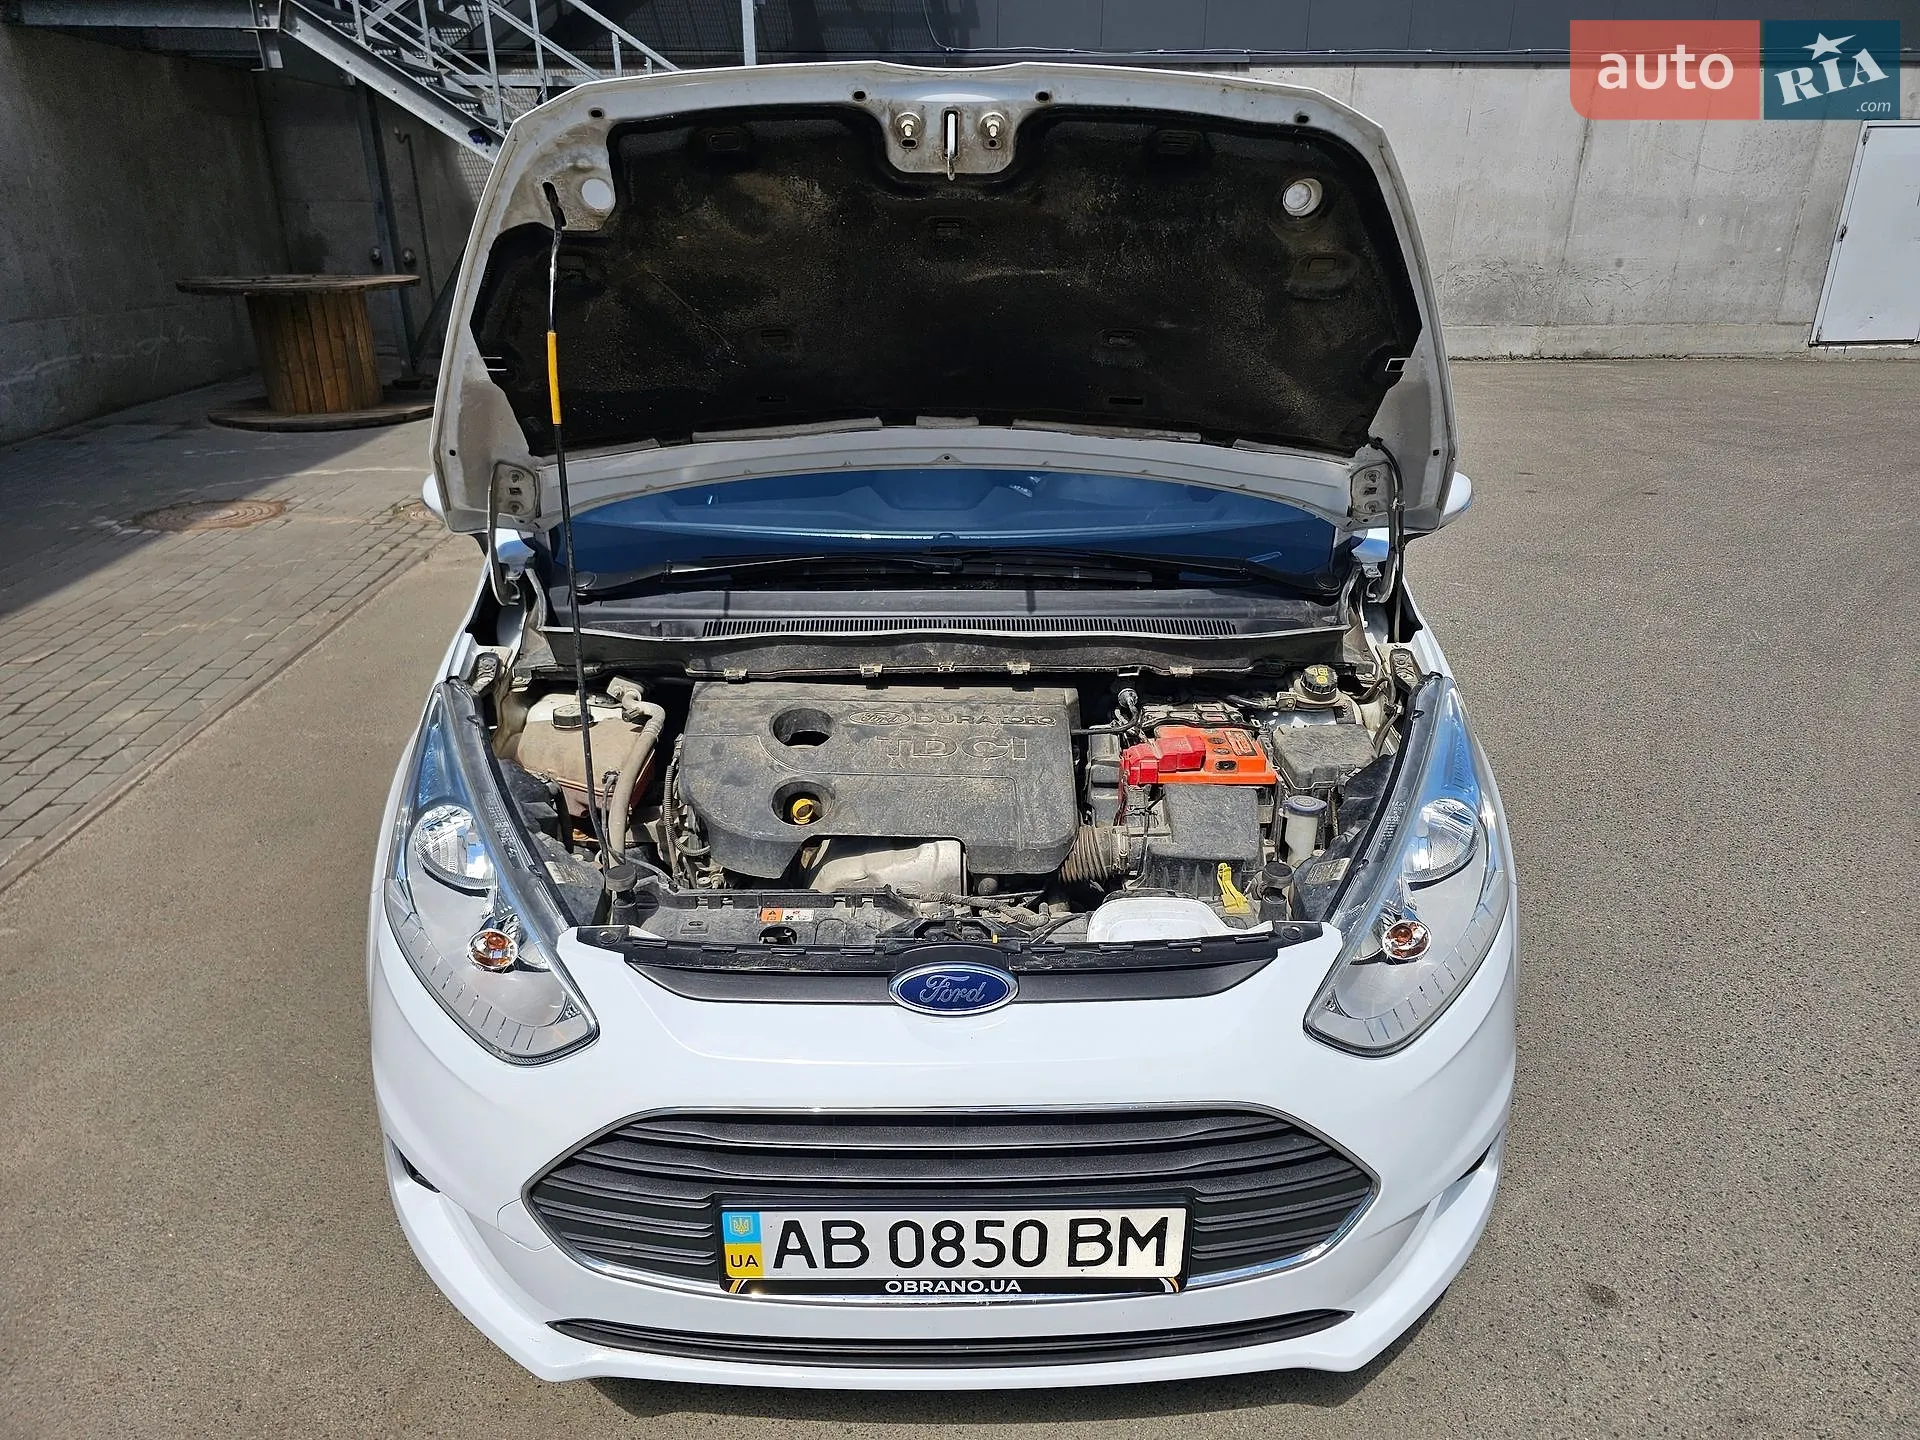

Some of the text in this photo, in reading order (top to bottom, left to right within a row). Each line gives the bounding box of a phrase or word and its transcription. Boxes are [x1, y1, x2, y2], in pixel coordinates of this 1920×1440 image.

[919, 974, 986, 1003] Ford
[772, 1216, 1169, 1269] AB 0850 BM
[730, 1254, 759, 1268] UA
[884, 1279, 1023, 1293] OBRANO.UA
